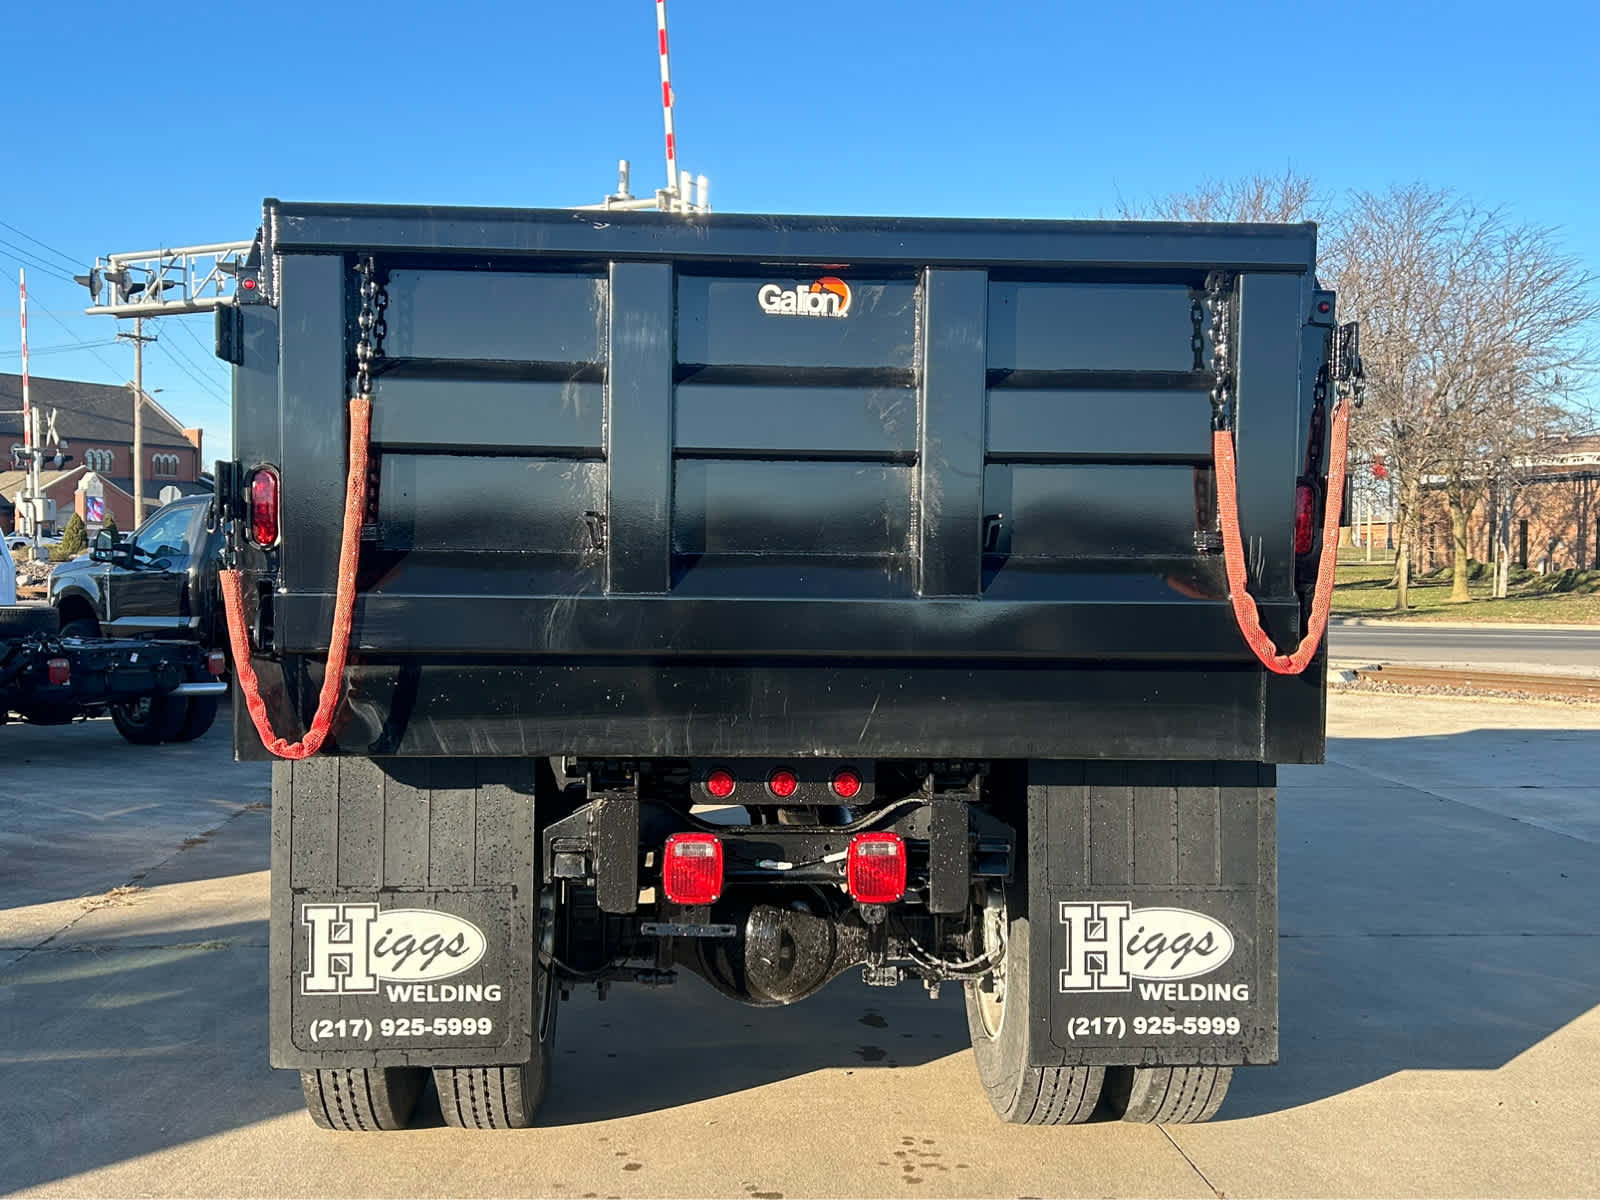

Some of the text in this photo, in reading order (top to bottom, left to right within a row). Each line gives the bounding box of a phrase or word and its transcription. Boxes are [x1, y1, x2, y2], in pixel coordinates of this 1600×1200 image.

[758, 284, 840, 312] Galion
[301, 903, 470, 995] Higgs
[1059, 901, 1219, 993] Higgs
[386, 985, 501, 1002] WELDING
[1139, 984, 1249, 1001] WELDING
[310, 1018, 493, 1042] (217) 925-5999
[1067, 1017, 1241, 1040] (217) 925-5999
